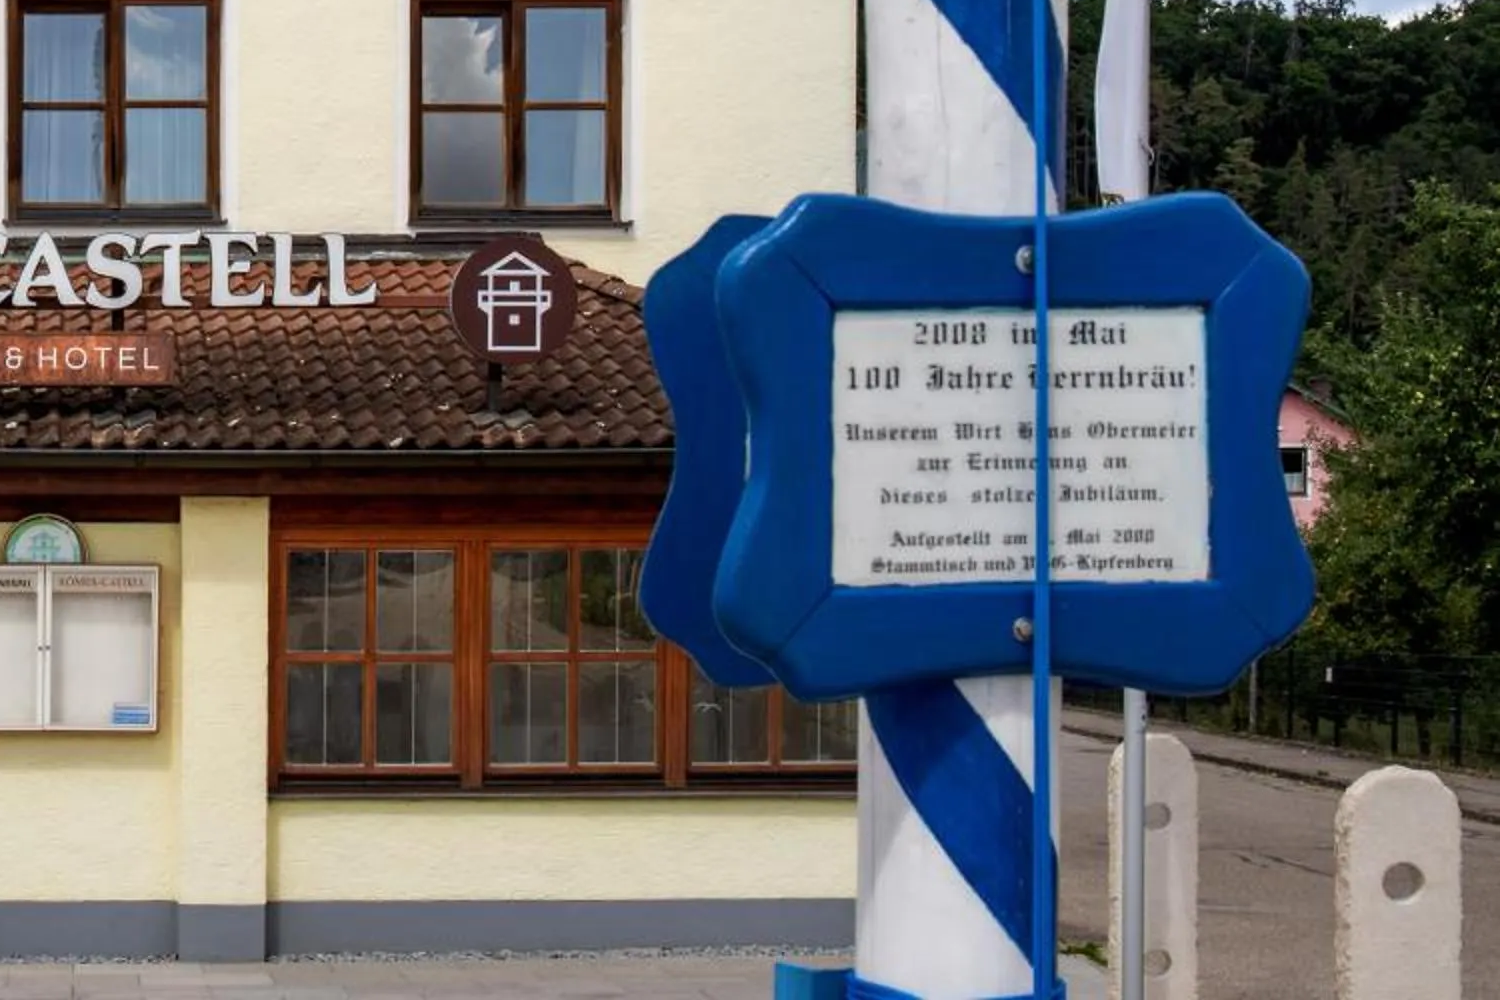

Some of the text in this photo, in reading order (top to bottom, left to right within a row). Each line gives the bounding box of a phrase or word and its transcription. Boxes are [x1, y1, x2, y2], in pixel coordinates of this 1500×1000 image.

[913, 321, 987, 346] 2008
[1068, 320, 1127, 346] Mai
[4, 345, 24, 370] &
[37, 345, 160, 370] HOTEL
[847, 365, 901, 391] 100
[925, 364, 1014, 394] Jahre
[844, 421, 1197, 443] Unserem Wirt Hns Obermeier
[966, 453, 1088, 473] Erinneung
[880, 486, 948, 505] dieses
